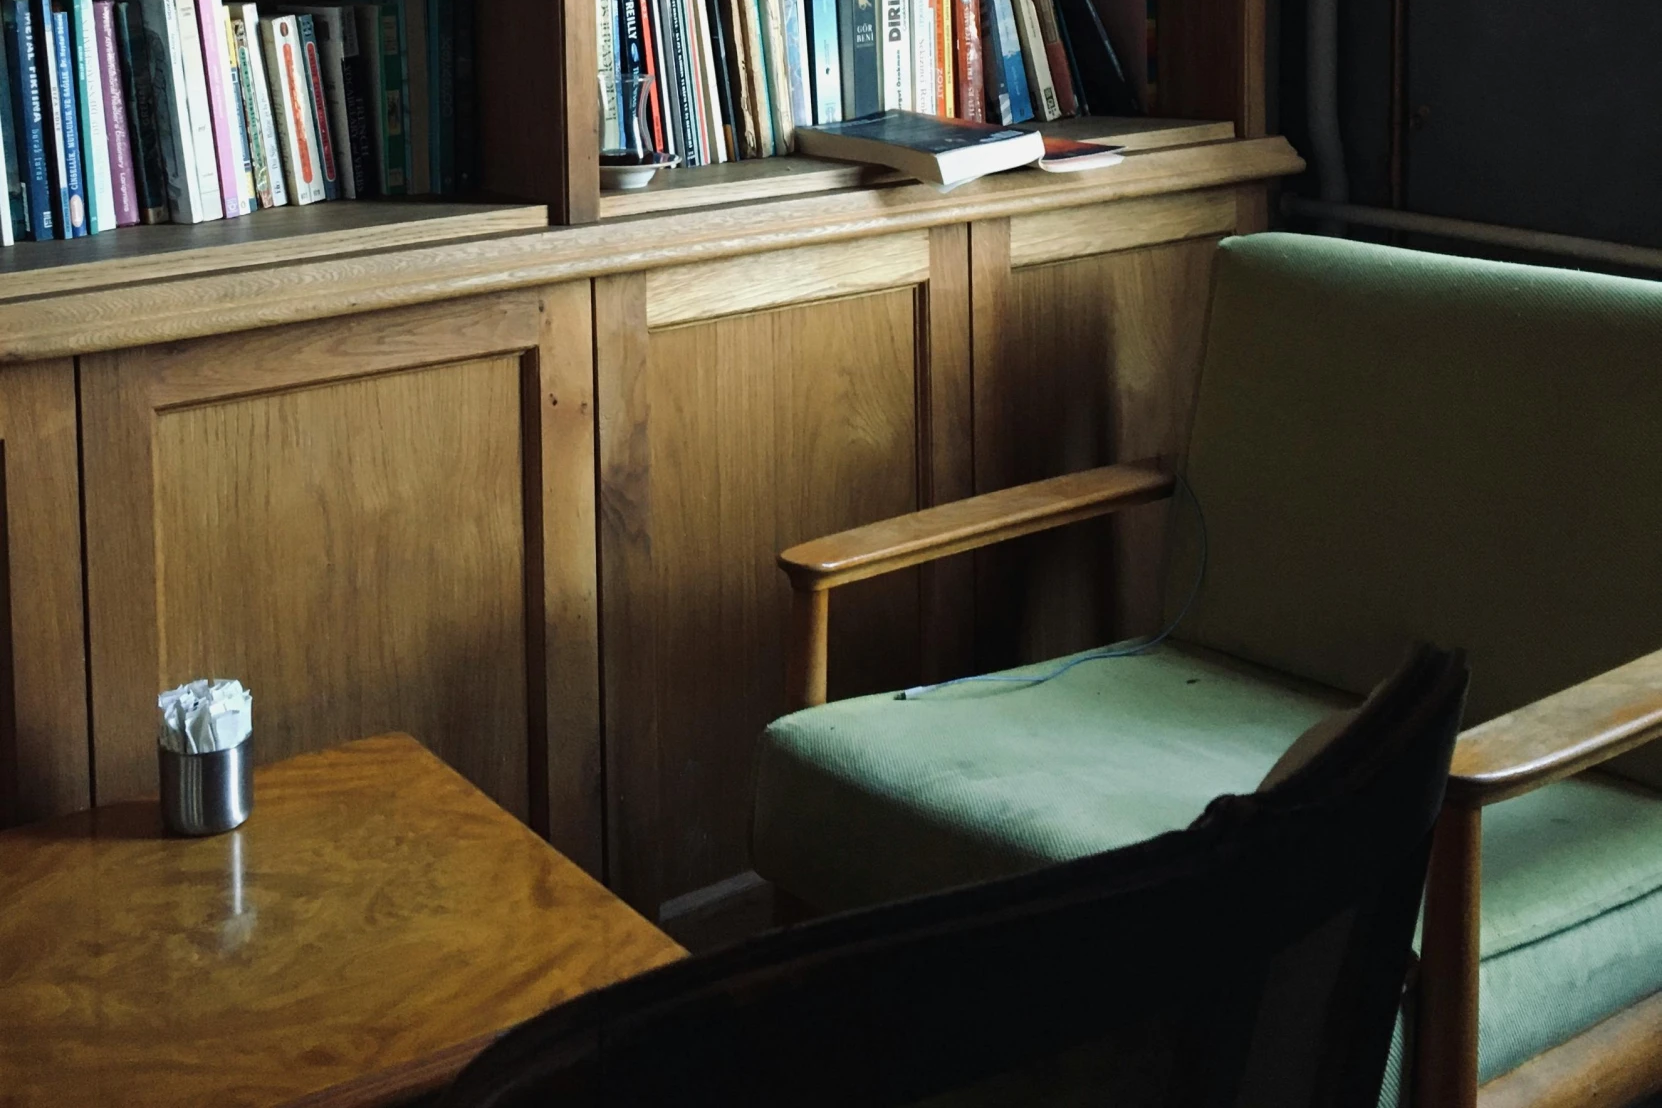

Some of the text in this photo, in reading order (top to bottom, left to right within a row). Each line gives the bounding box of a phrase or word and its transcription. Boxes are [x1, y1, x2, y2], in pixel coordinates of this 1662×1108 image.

[857, 23, 873, 34] GÖR
[112, 130, 125, 168] Dictionary
[118, 172, 130, 212] Longmans
